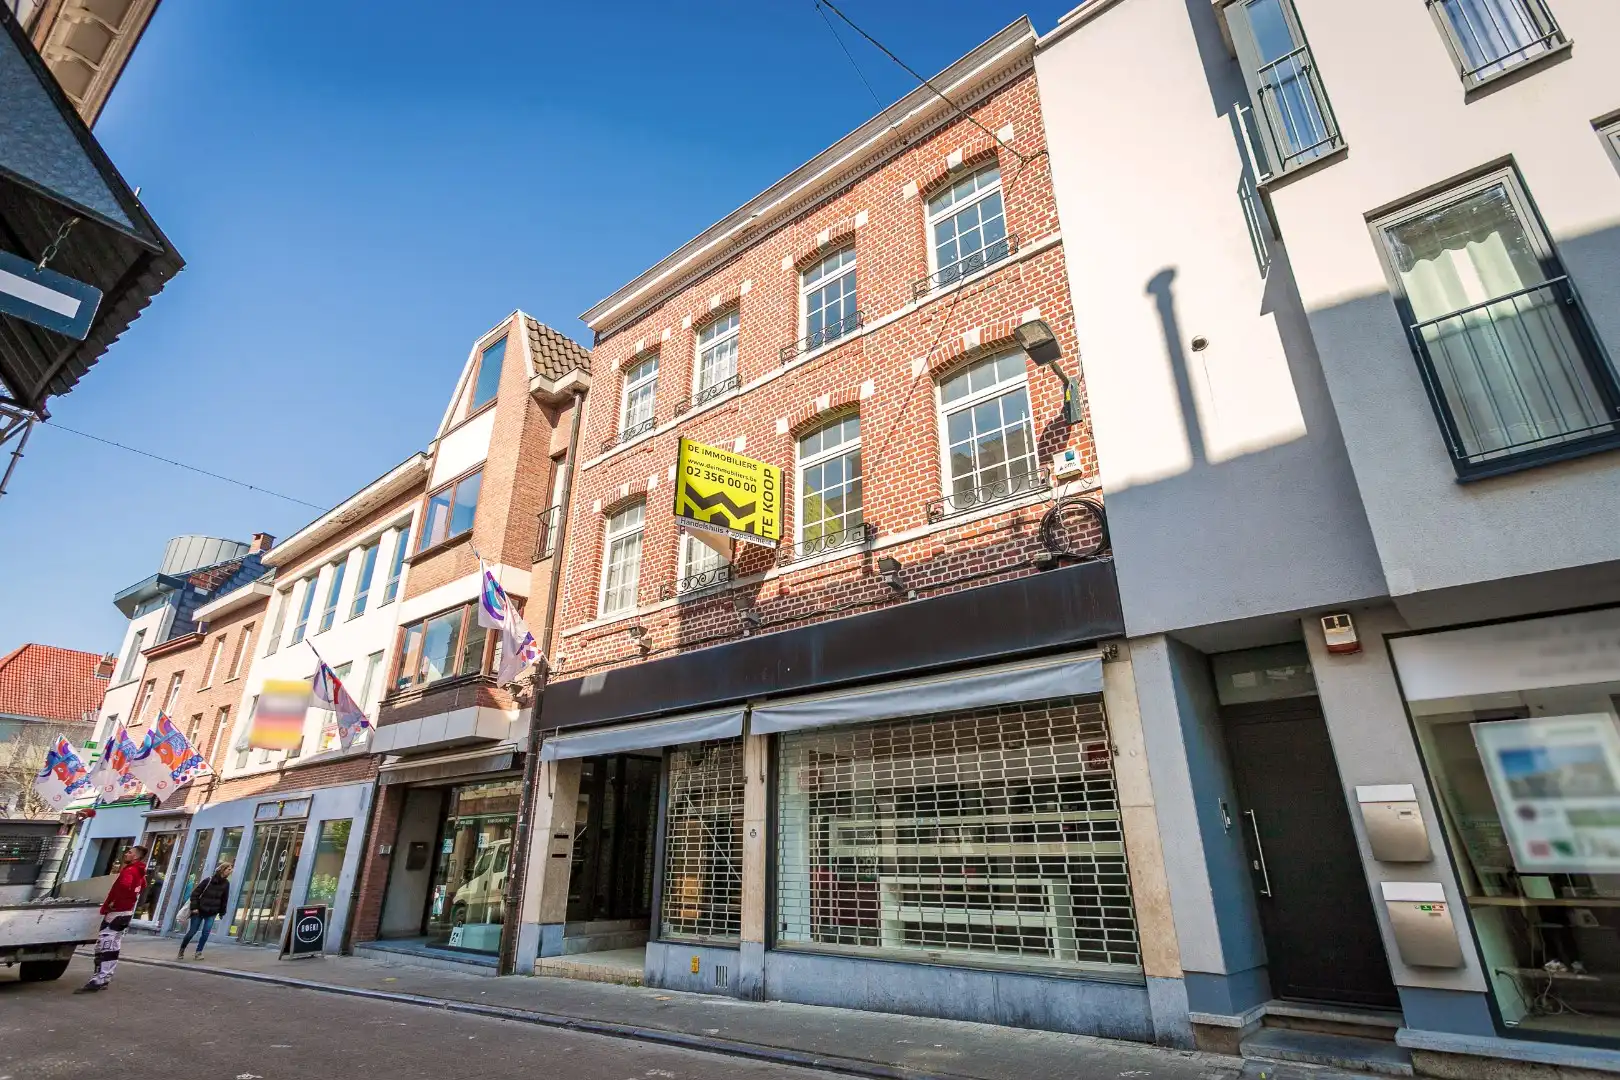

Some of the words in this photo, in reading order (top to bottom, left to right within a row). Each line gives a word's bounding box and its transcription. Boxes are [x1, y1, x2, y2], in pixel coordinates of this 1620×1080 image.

[688, 444, 700, 454] DE
[702, 449, 758, 471] IMMOBILIERS
[686, 466, 701, 478] 02
[704, 470, 725, 484] 356
[727, 478, 741, 489] 00
[743, 482, 757, 494] 00
[763, 468, 774, 513] KOOP
[762, 516, 773, 537] TE
